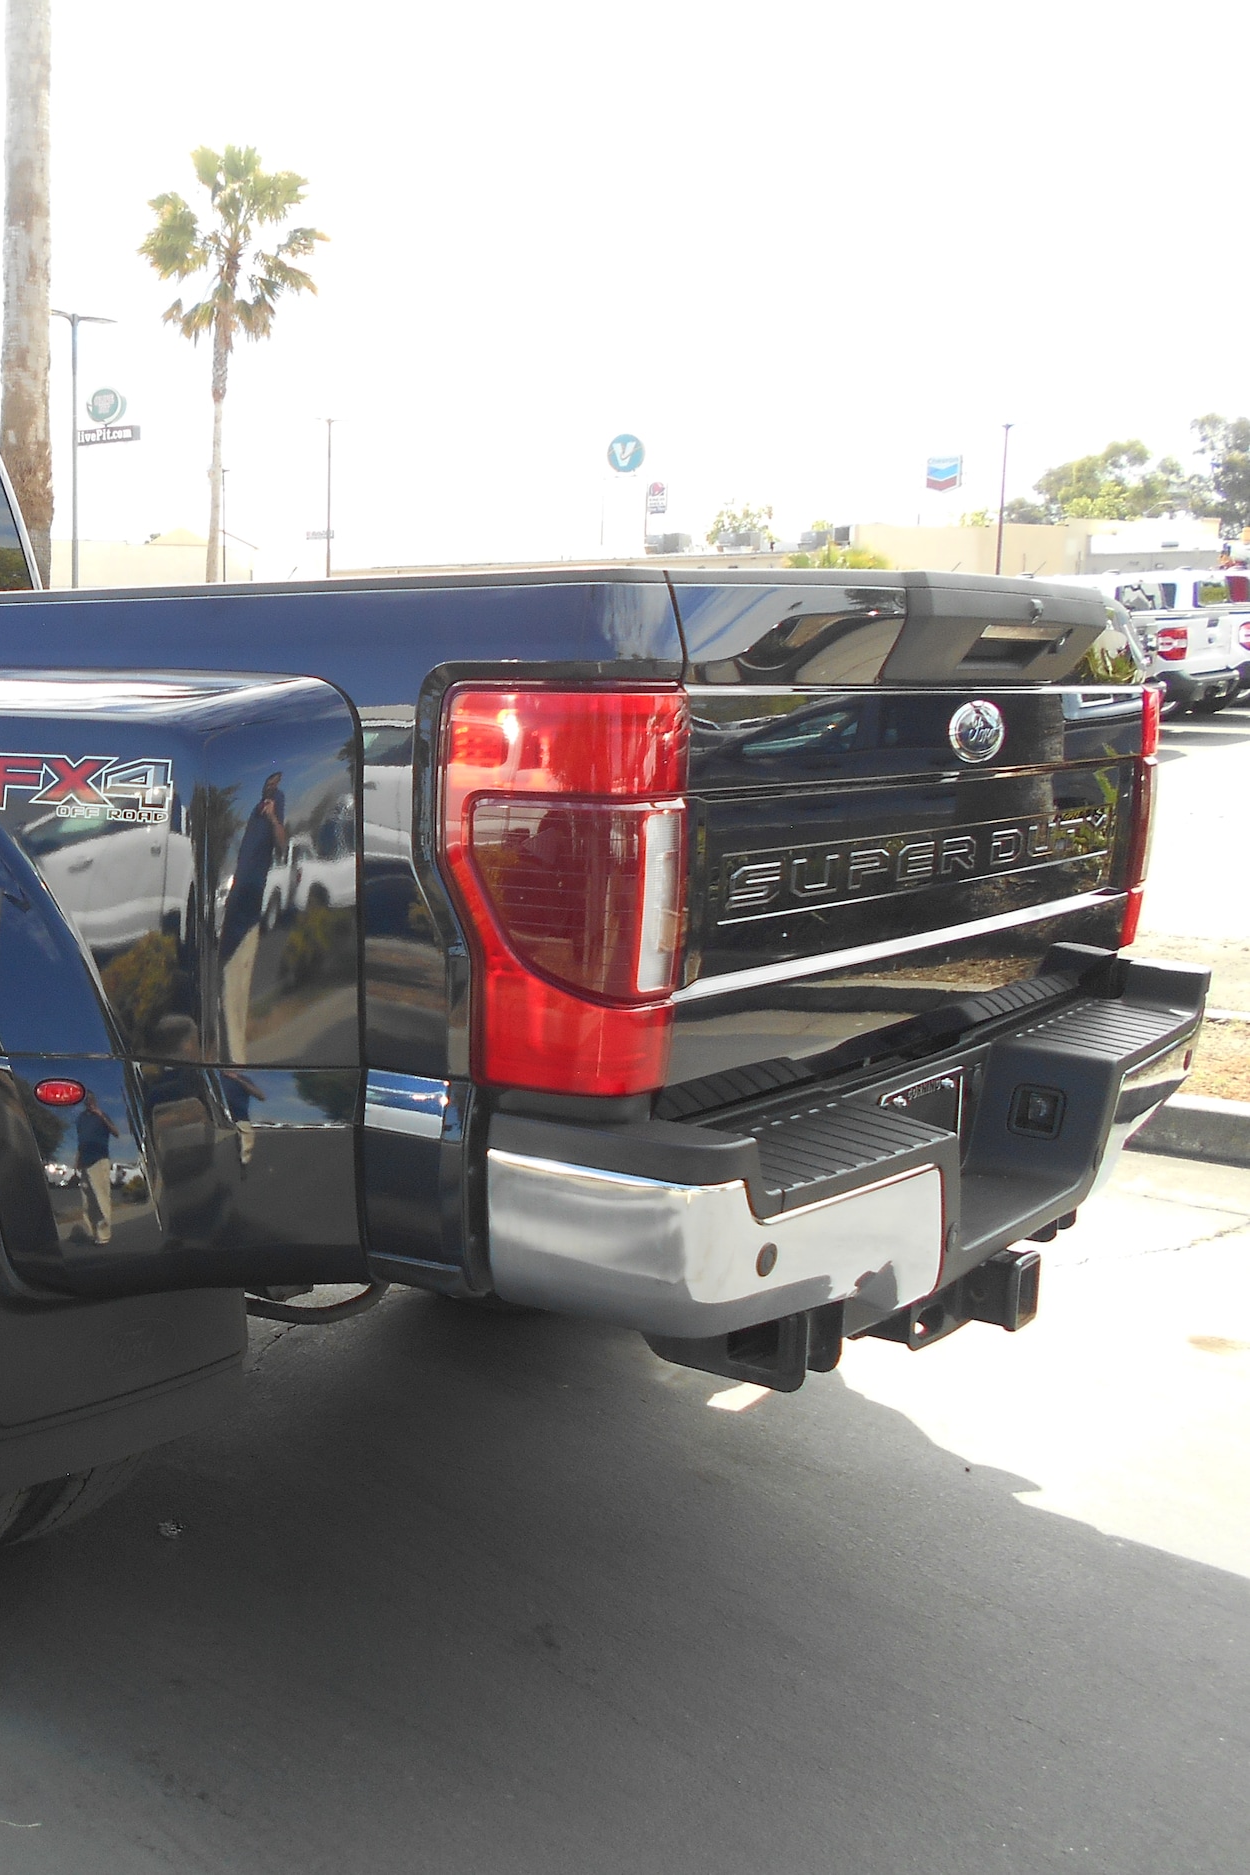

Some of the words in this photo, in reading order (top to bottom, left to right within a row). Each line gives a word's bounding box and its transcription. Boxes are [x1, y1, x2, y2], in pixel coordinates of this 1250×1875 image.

[77, 428, 132, 443] livePit.com
[56, 805, 100, 818] OFF
[106, 808, 168, 823] ROAD
[724, 835, 977, 909] SUPER
[989, 809, 1107, 866] DUTY
